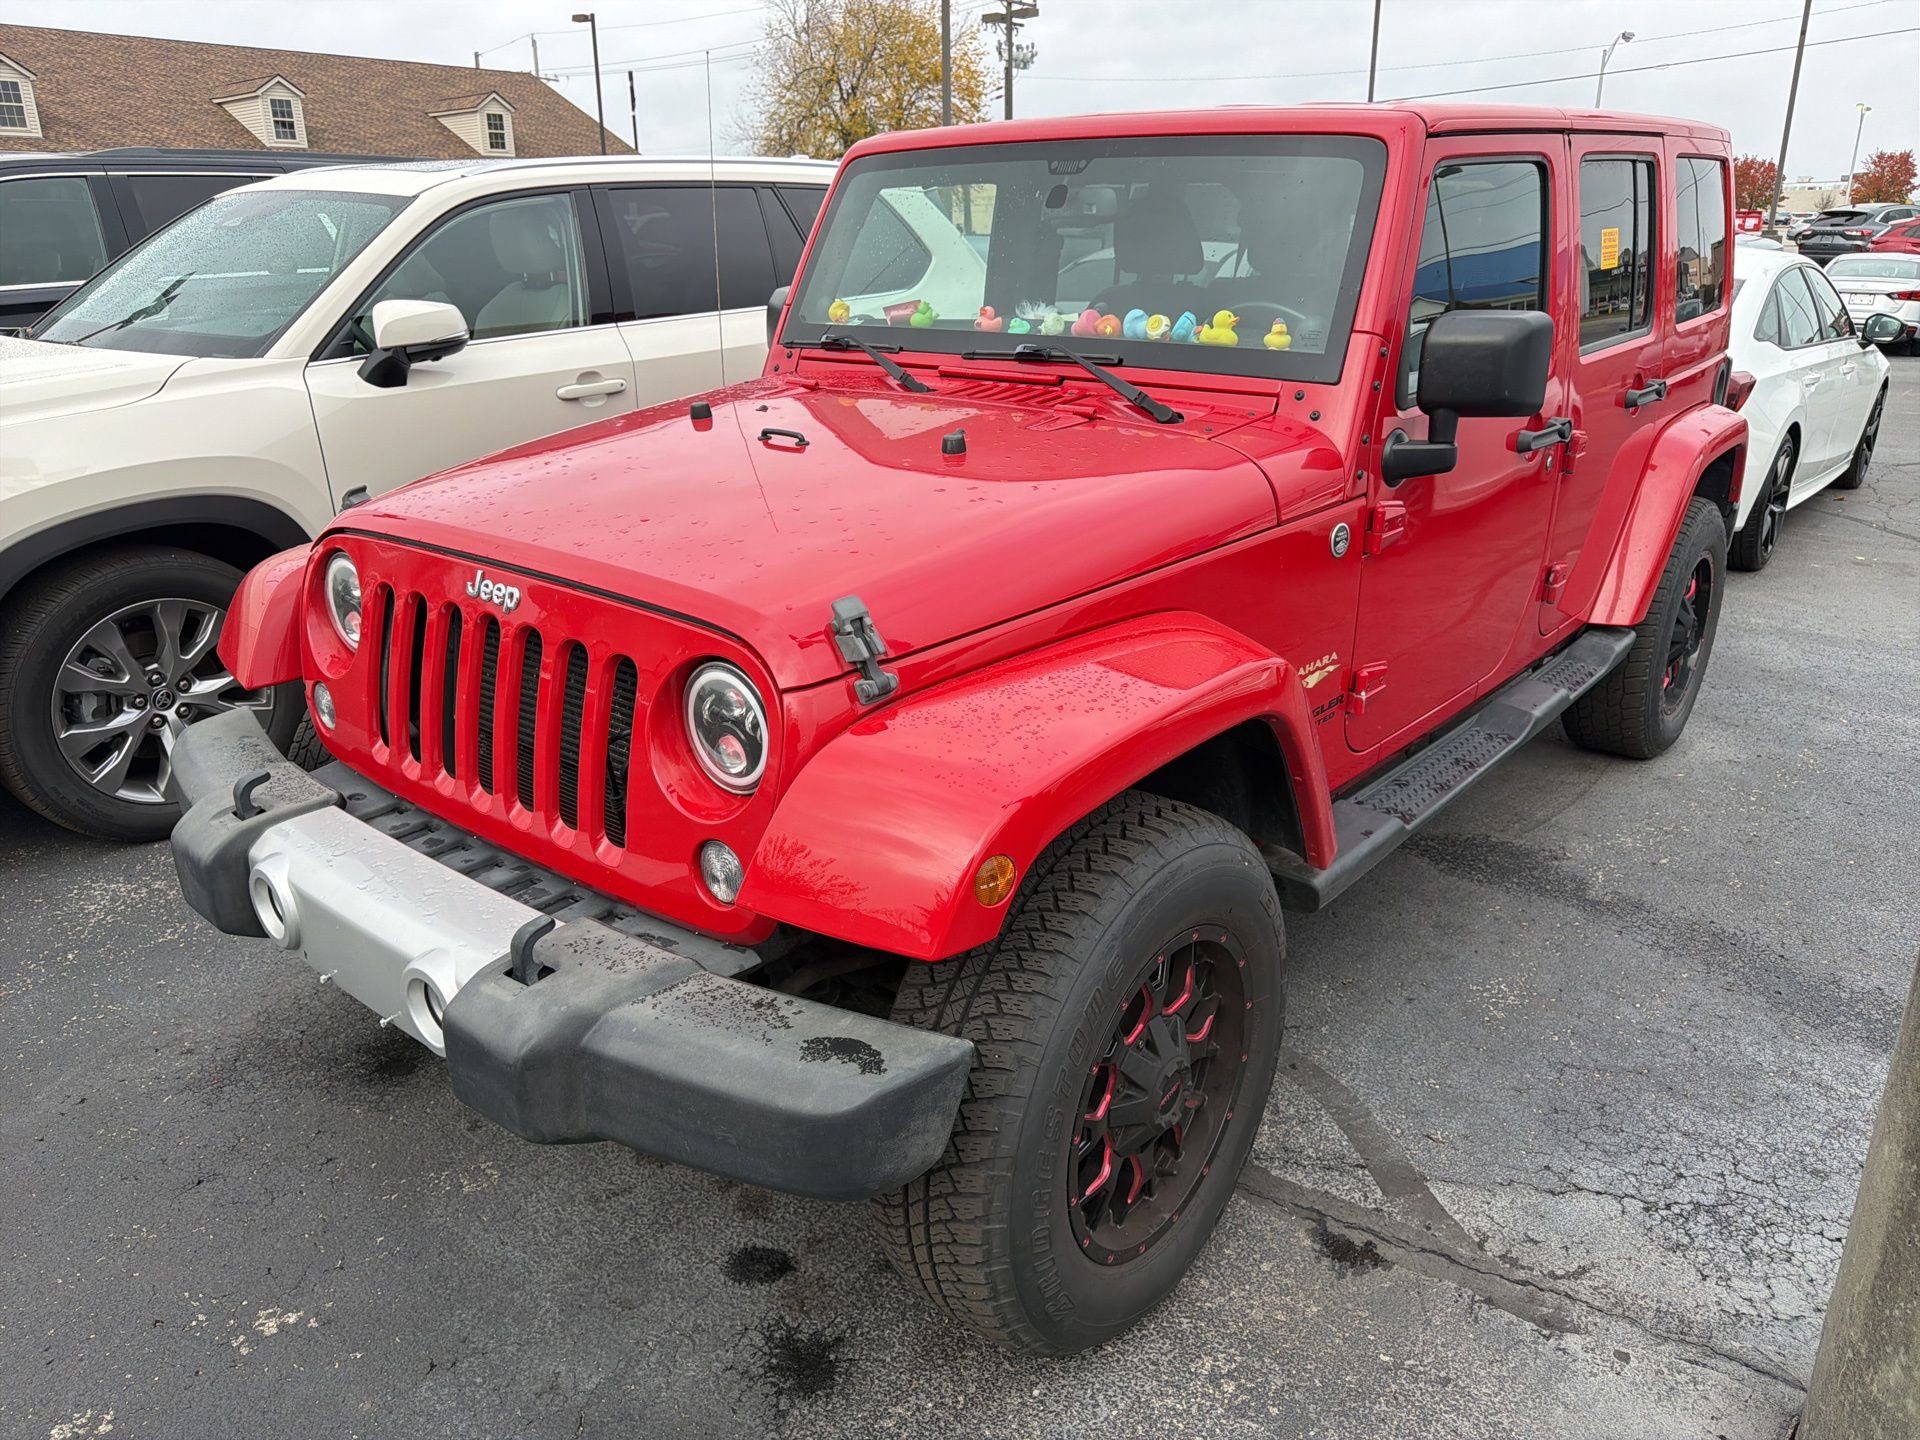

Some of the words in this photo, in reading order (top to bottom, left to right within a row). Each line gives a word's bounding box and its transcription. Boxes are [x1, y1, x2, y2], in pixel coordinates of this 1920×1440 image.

[466, 569, 520, 614] Jeep
[1298, 652, 1338, 676] AHARA
[1312, 693, 1345, 718] GLER
